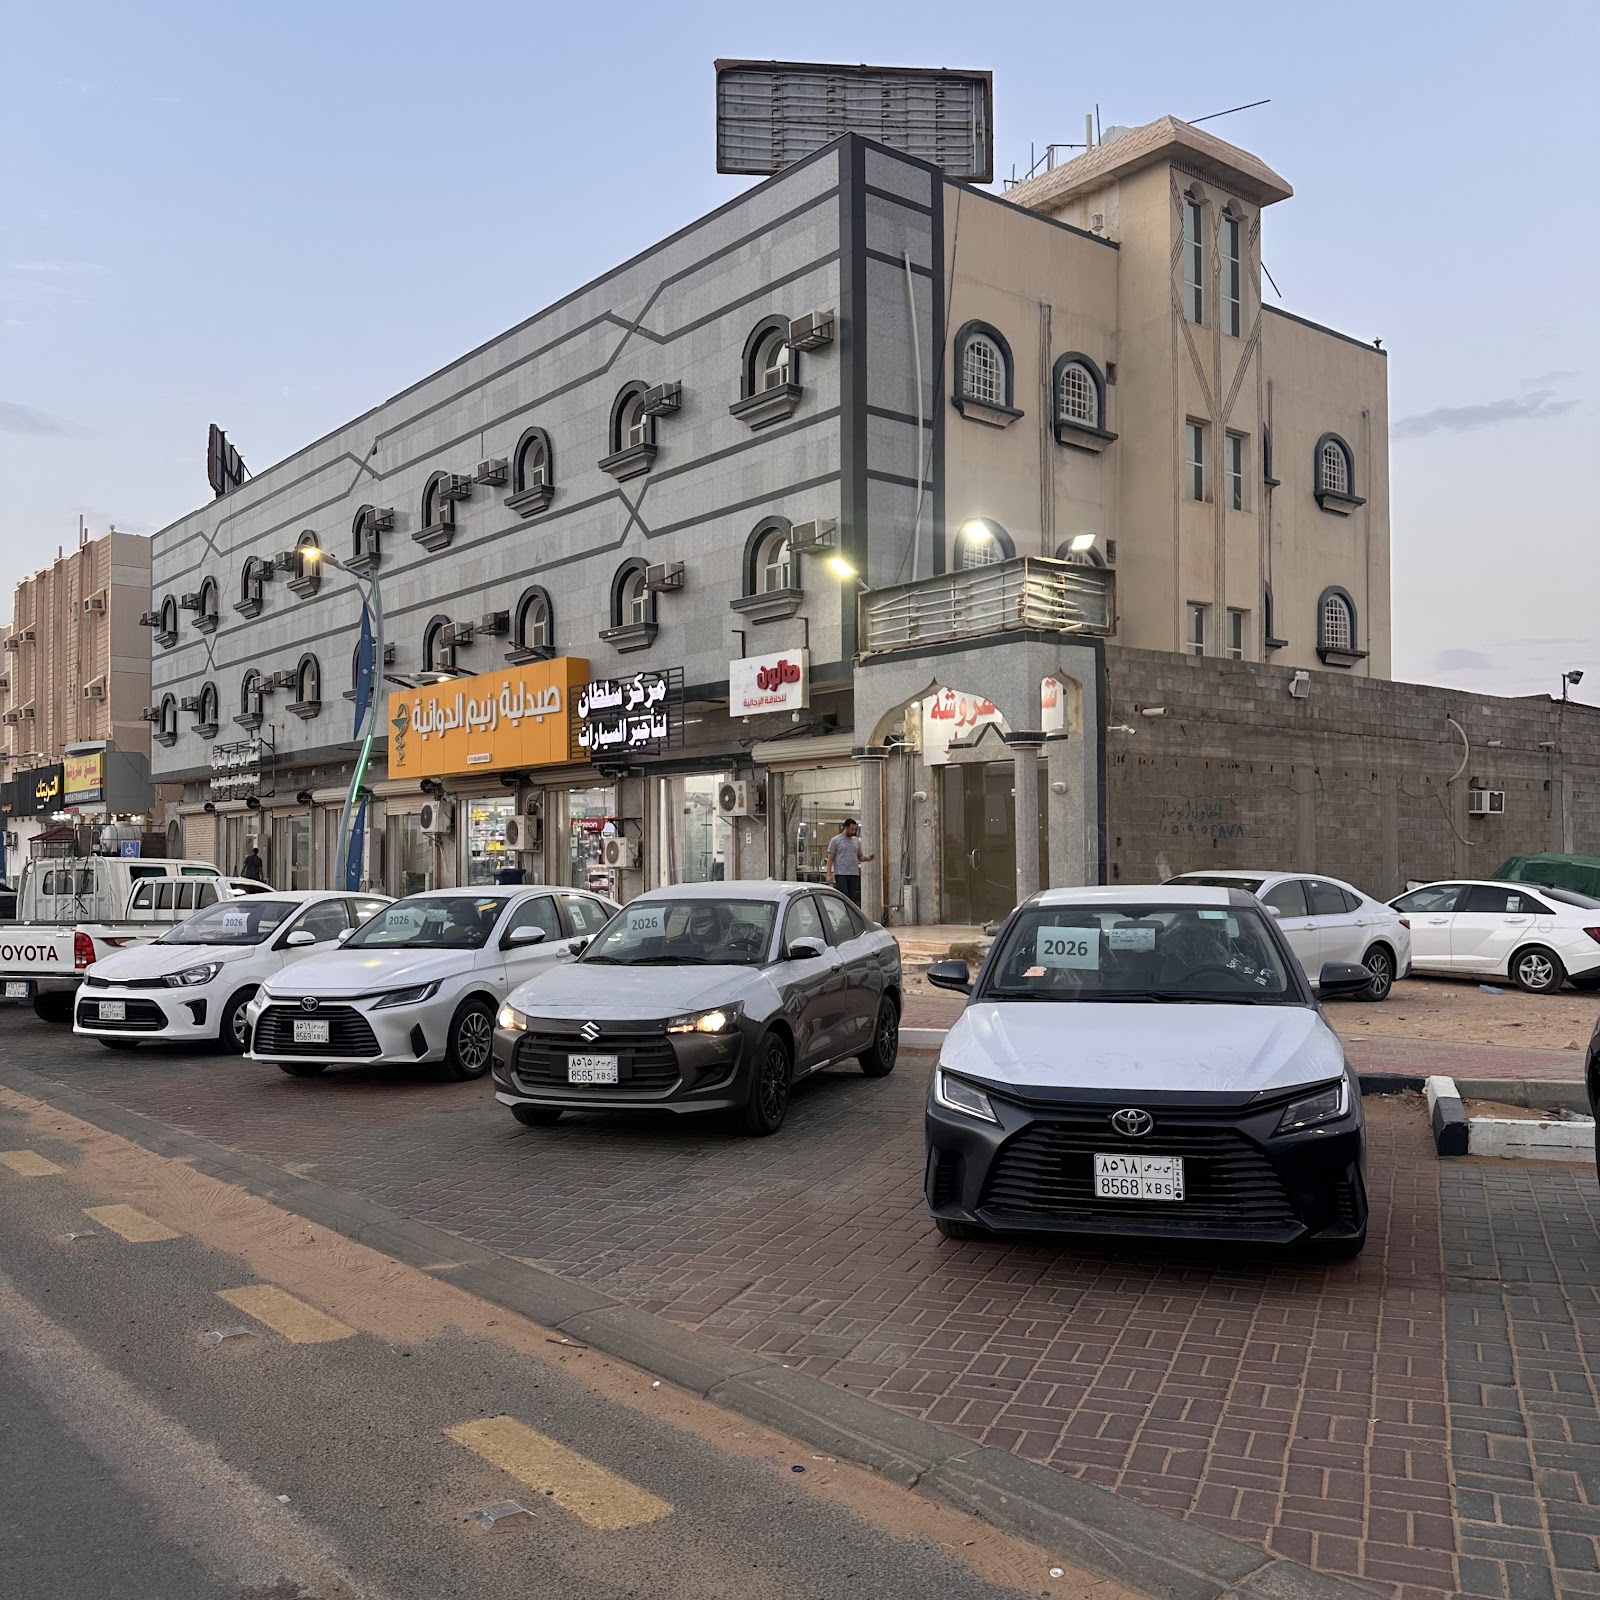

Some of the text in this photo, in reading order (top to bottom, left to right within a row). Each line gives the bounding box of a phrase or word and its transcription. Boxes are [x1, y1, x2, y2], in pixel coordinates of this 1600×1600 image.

[757, 660, 800, 691] صالون
[578, 673, 666, 718] مركز سلطان
[743, 694, 787, 708] للحلاقة الرجالية
[412, 681, 562, 741] صيدلية رنيم الدوائية
[578, 707, 667, 750] لتأجير السيارات
[225, 918, 243, 927] 2026
[389, 916, 409, 926] 2026
[632, 917, 658, 930] 2026
[0, 945, 59, 961] OYOTA
[1044, 940, 1088, 956] 2026
[295, 1032, 312, 1041] 8569
[571, 1057, 593, 1067] ٨٥٦٥
[571, 1070, 593, 1082] 8565
[1101, 1157, 1138, 1175] ٨٥٦٨
[1101, 1177, 1172, 1195] 8568 XBS
